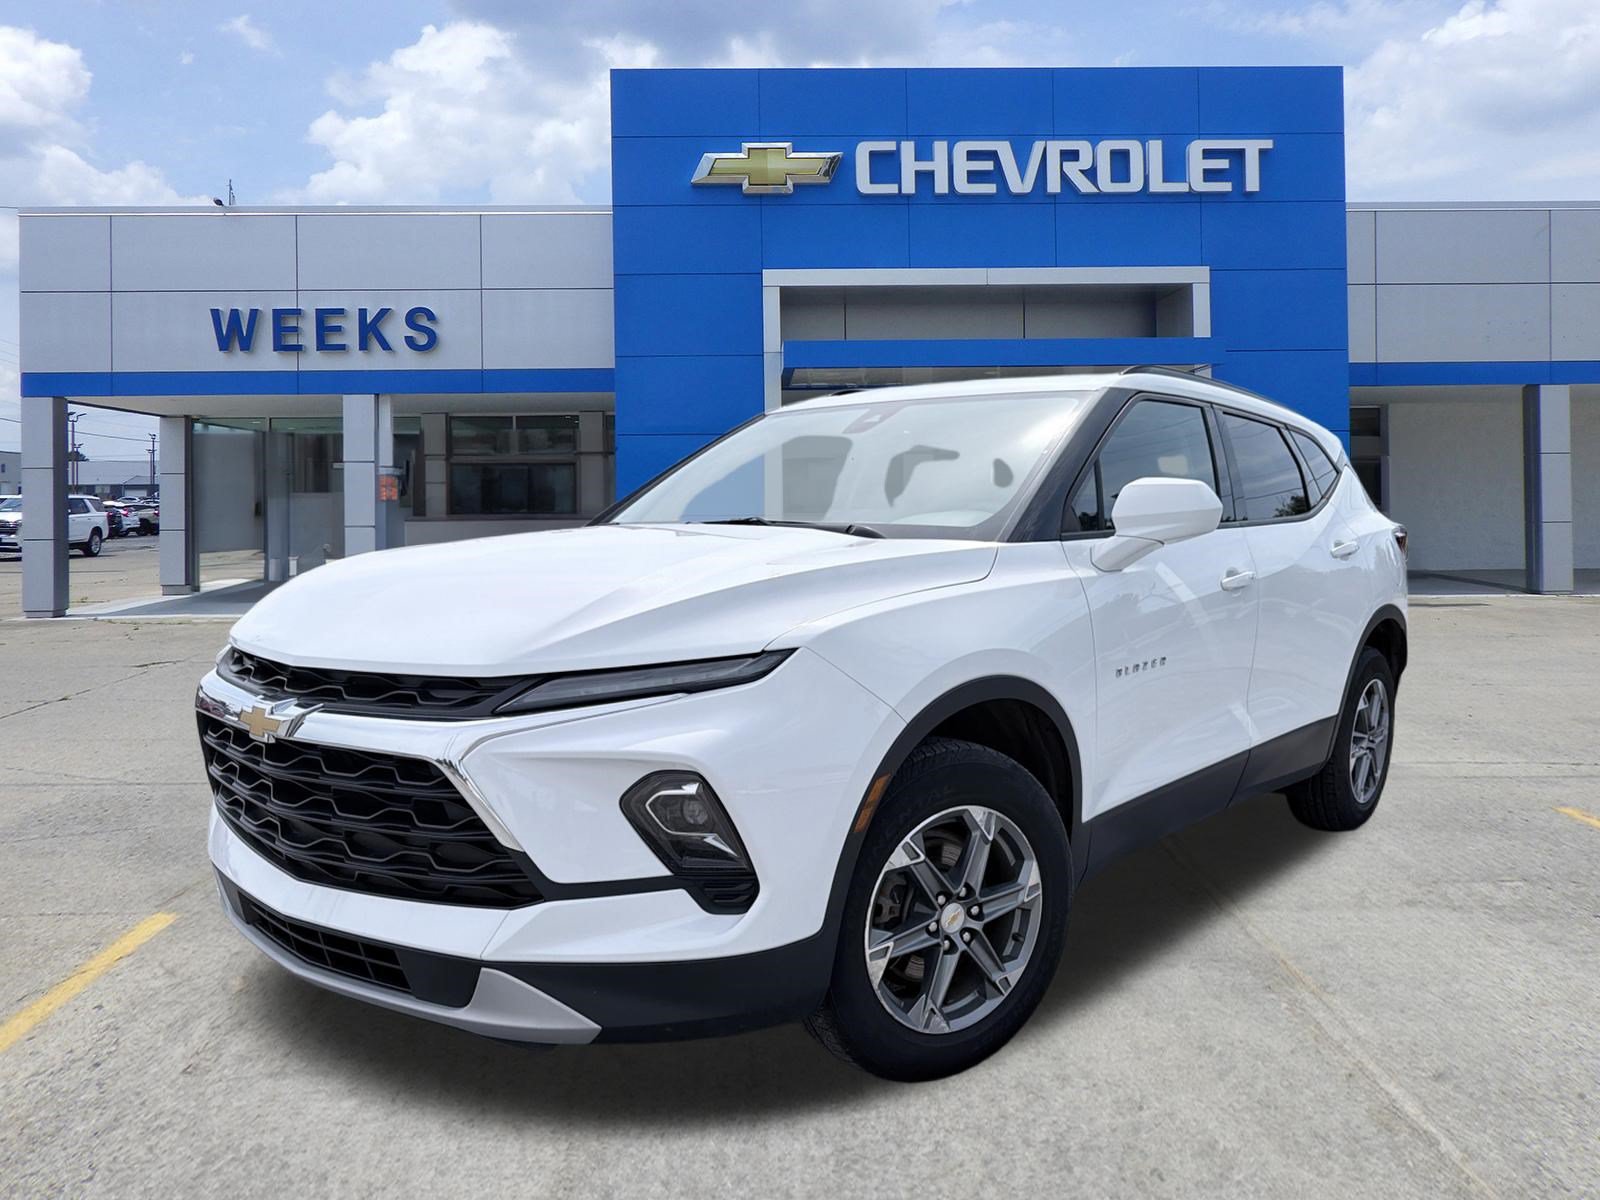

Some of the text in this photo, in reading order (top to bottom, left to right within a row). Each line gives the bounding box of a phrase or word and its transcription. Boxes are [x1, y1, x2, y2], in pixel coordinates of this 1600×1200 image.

[855, 138, 1274, 195] CHEVROLET
[210, 306, 438, 354] WEEKS
[1115, 656, 1167, 678] BLAZER
